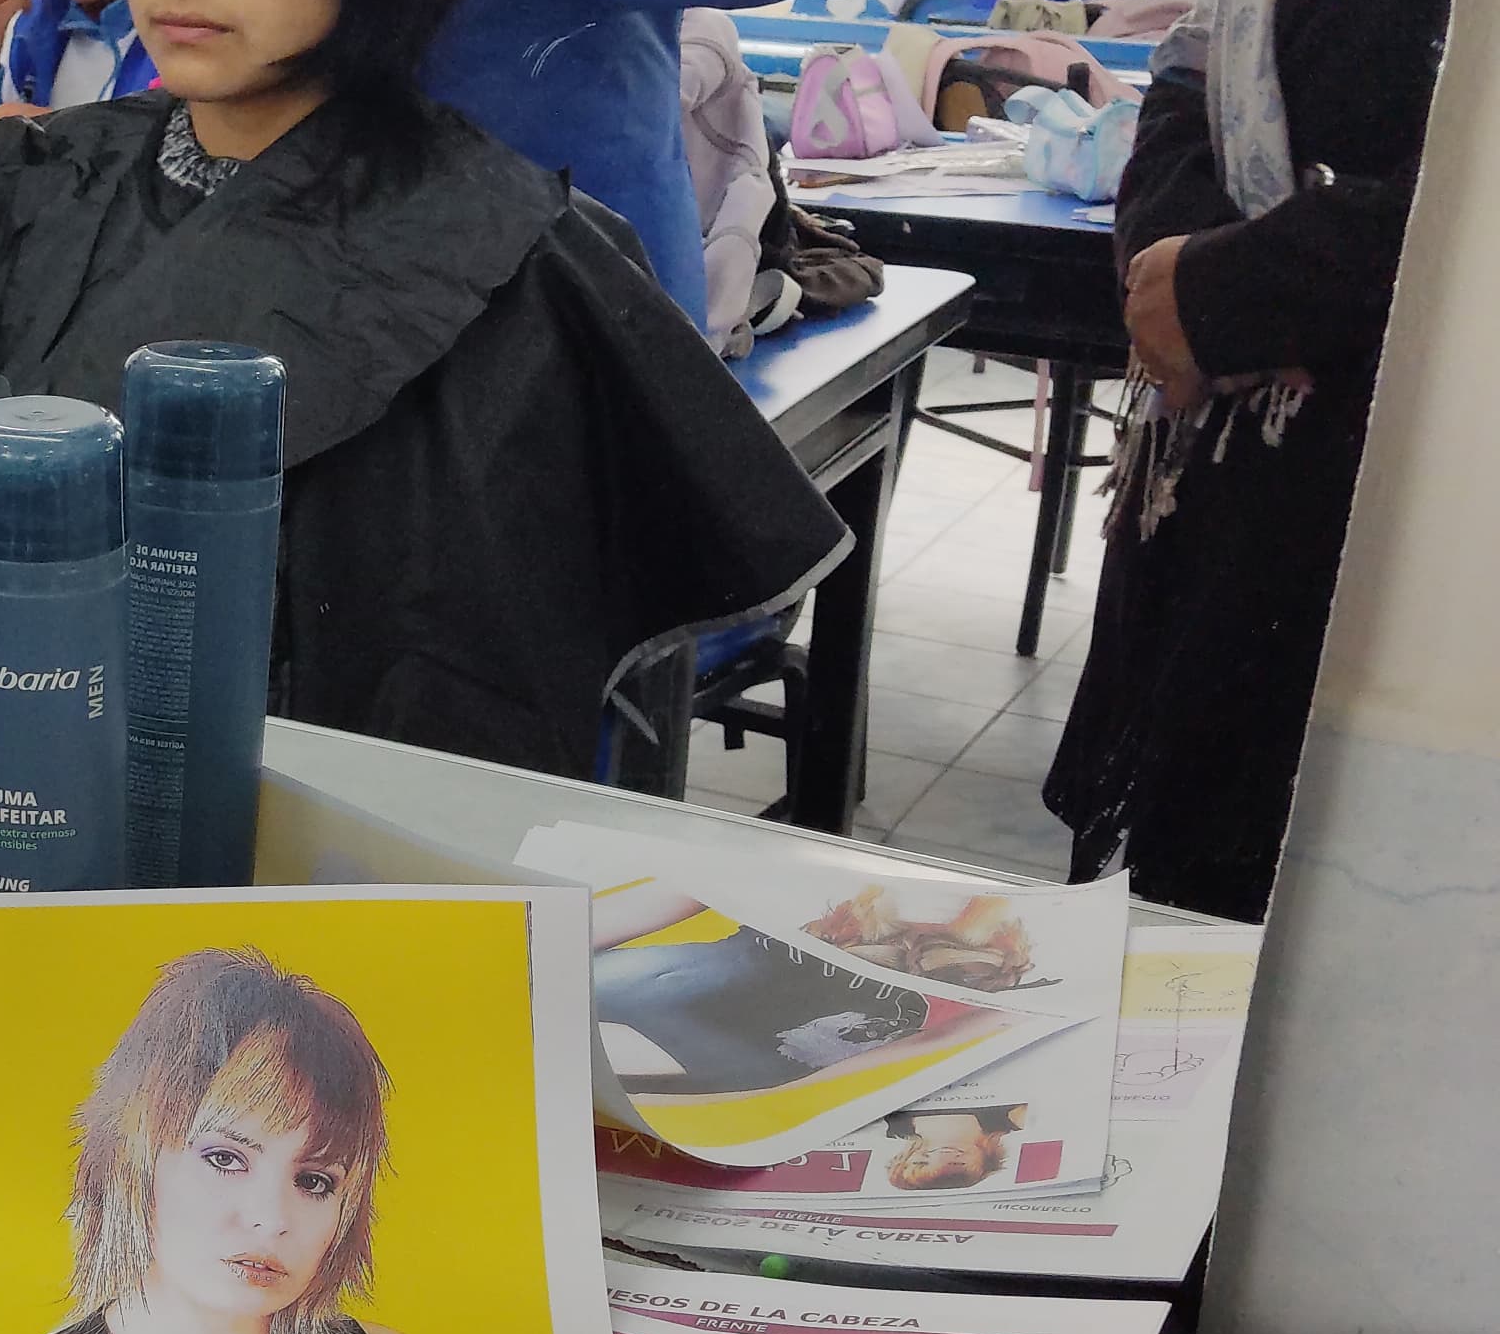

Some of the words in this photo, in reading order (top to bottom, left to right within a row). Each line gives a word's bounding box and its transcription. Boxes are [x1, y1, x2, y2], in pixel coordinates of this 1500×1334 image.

[88, 665, 105, 719] MEN
[0, 828, 28, 839] extra
[30, 828, 77, 839] cremosa
[699, 1300, 741, 1315] DE
[750, 1306, 787, 1320] LA
[799, 1312, 921, 1328] CABEZA
[695, 1318, 769, 1333] FRENTE
